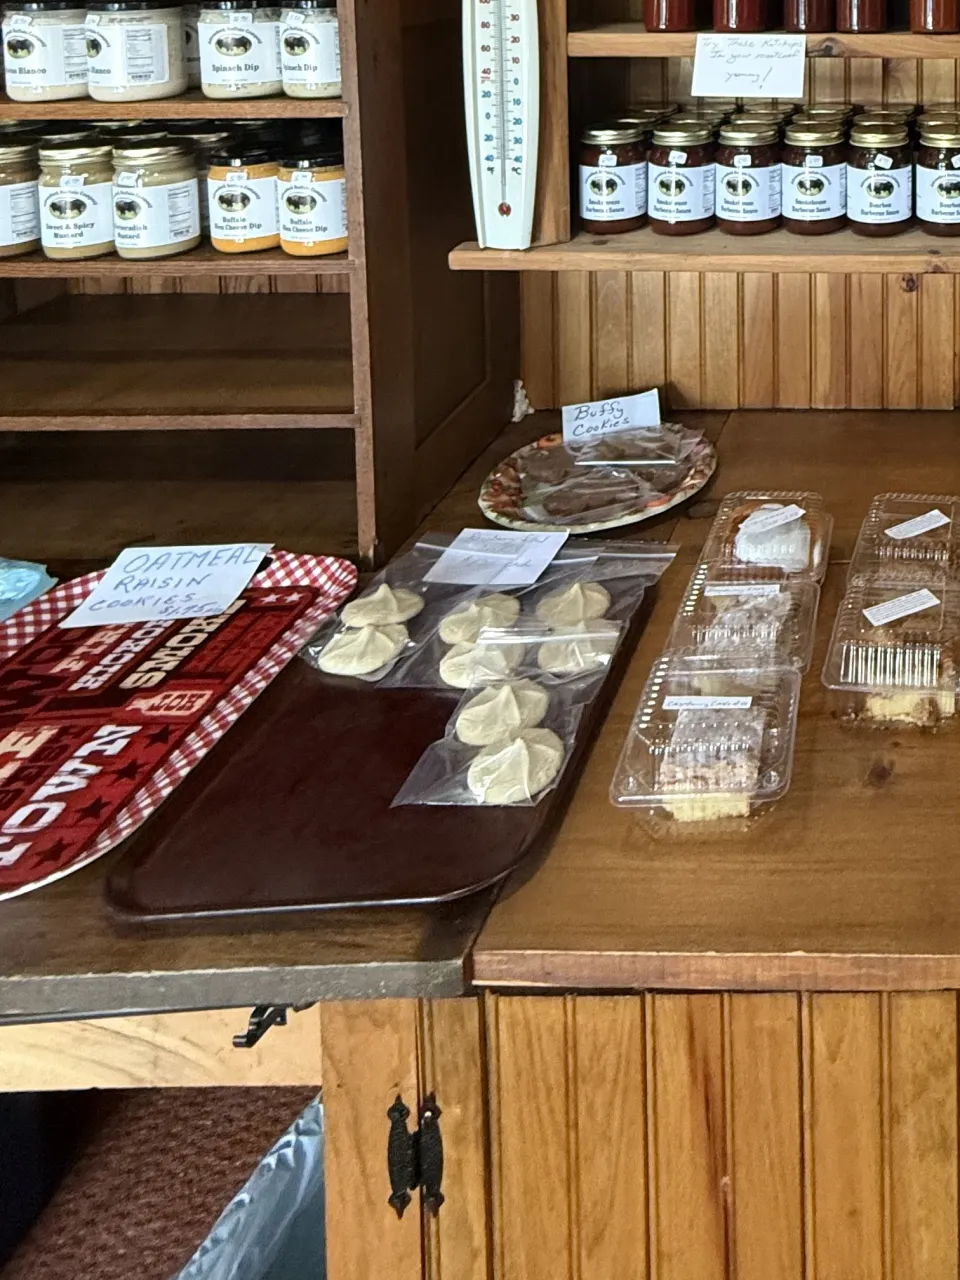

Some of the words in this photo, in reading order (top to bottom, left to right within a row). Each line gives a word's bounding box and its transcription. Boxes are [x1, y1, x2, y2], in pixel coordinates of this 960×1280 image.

[481, 21, 490, 29] 80
[481, 44, 490, 52] 60
[211, 64, 242, 73] Spinach
[244, 64, 260, 72] Dip
[303, 64, 318, 72] Dip
[513, 98, 521, 106] 10
[485, 112, 491, 120] 0
[572, 417, 630, 436] Cookies
[122, 545, 259, 574] OATMEAL
[113, 573, 212, 593] RAISIN
[88, 593, 197, 611] COOKIES
[50, 622, 136, 673] FIR
[119, 598, 247, 689] SMOK
